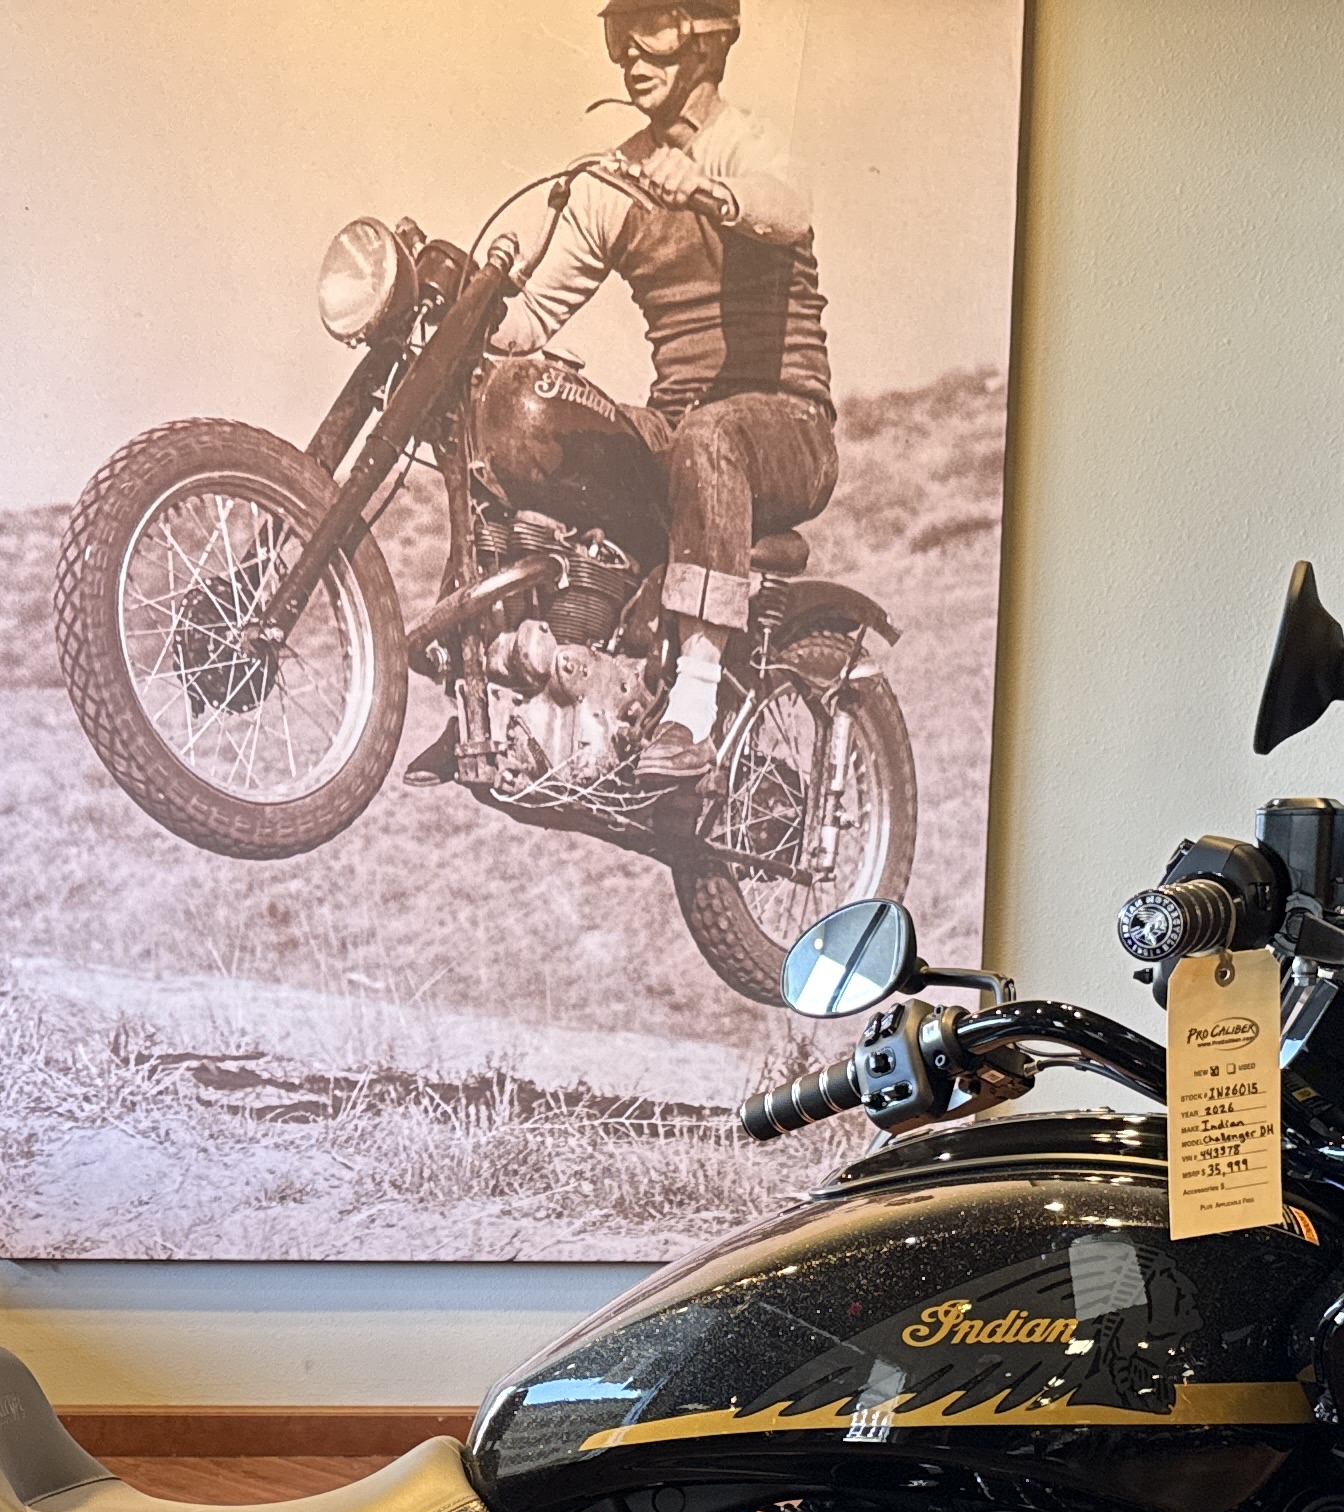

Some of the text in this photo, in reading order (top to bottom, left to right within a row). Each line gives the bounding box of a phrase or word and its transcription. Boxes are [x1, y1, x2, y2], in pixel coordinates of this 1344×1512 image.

[535, 368, 616, 422] Indian
[1181, 1093, 1202, 1102] STOCK
[1208, 1082, 1258, 1100] IN26015
[1181, 1102, 1234, 1118] YEAR 2026
[1181, 1119, 1245, 1134] MAKE Indian
[1181, 1139, 1203, 1148] MODEL
[1203, 1129, 1257, 1143] Challenger
[1182, 1170, 1200, 1179] MSRP
[1207, 1158, 1249, 1177] 35,999
[901, 1299, 1079, 1348] Indian
